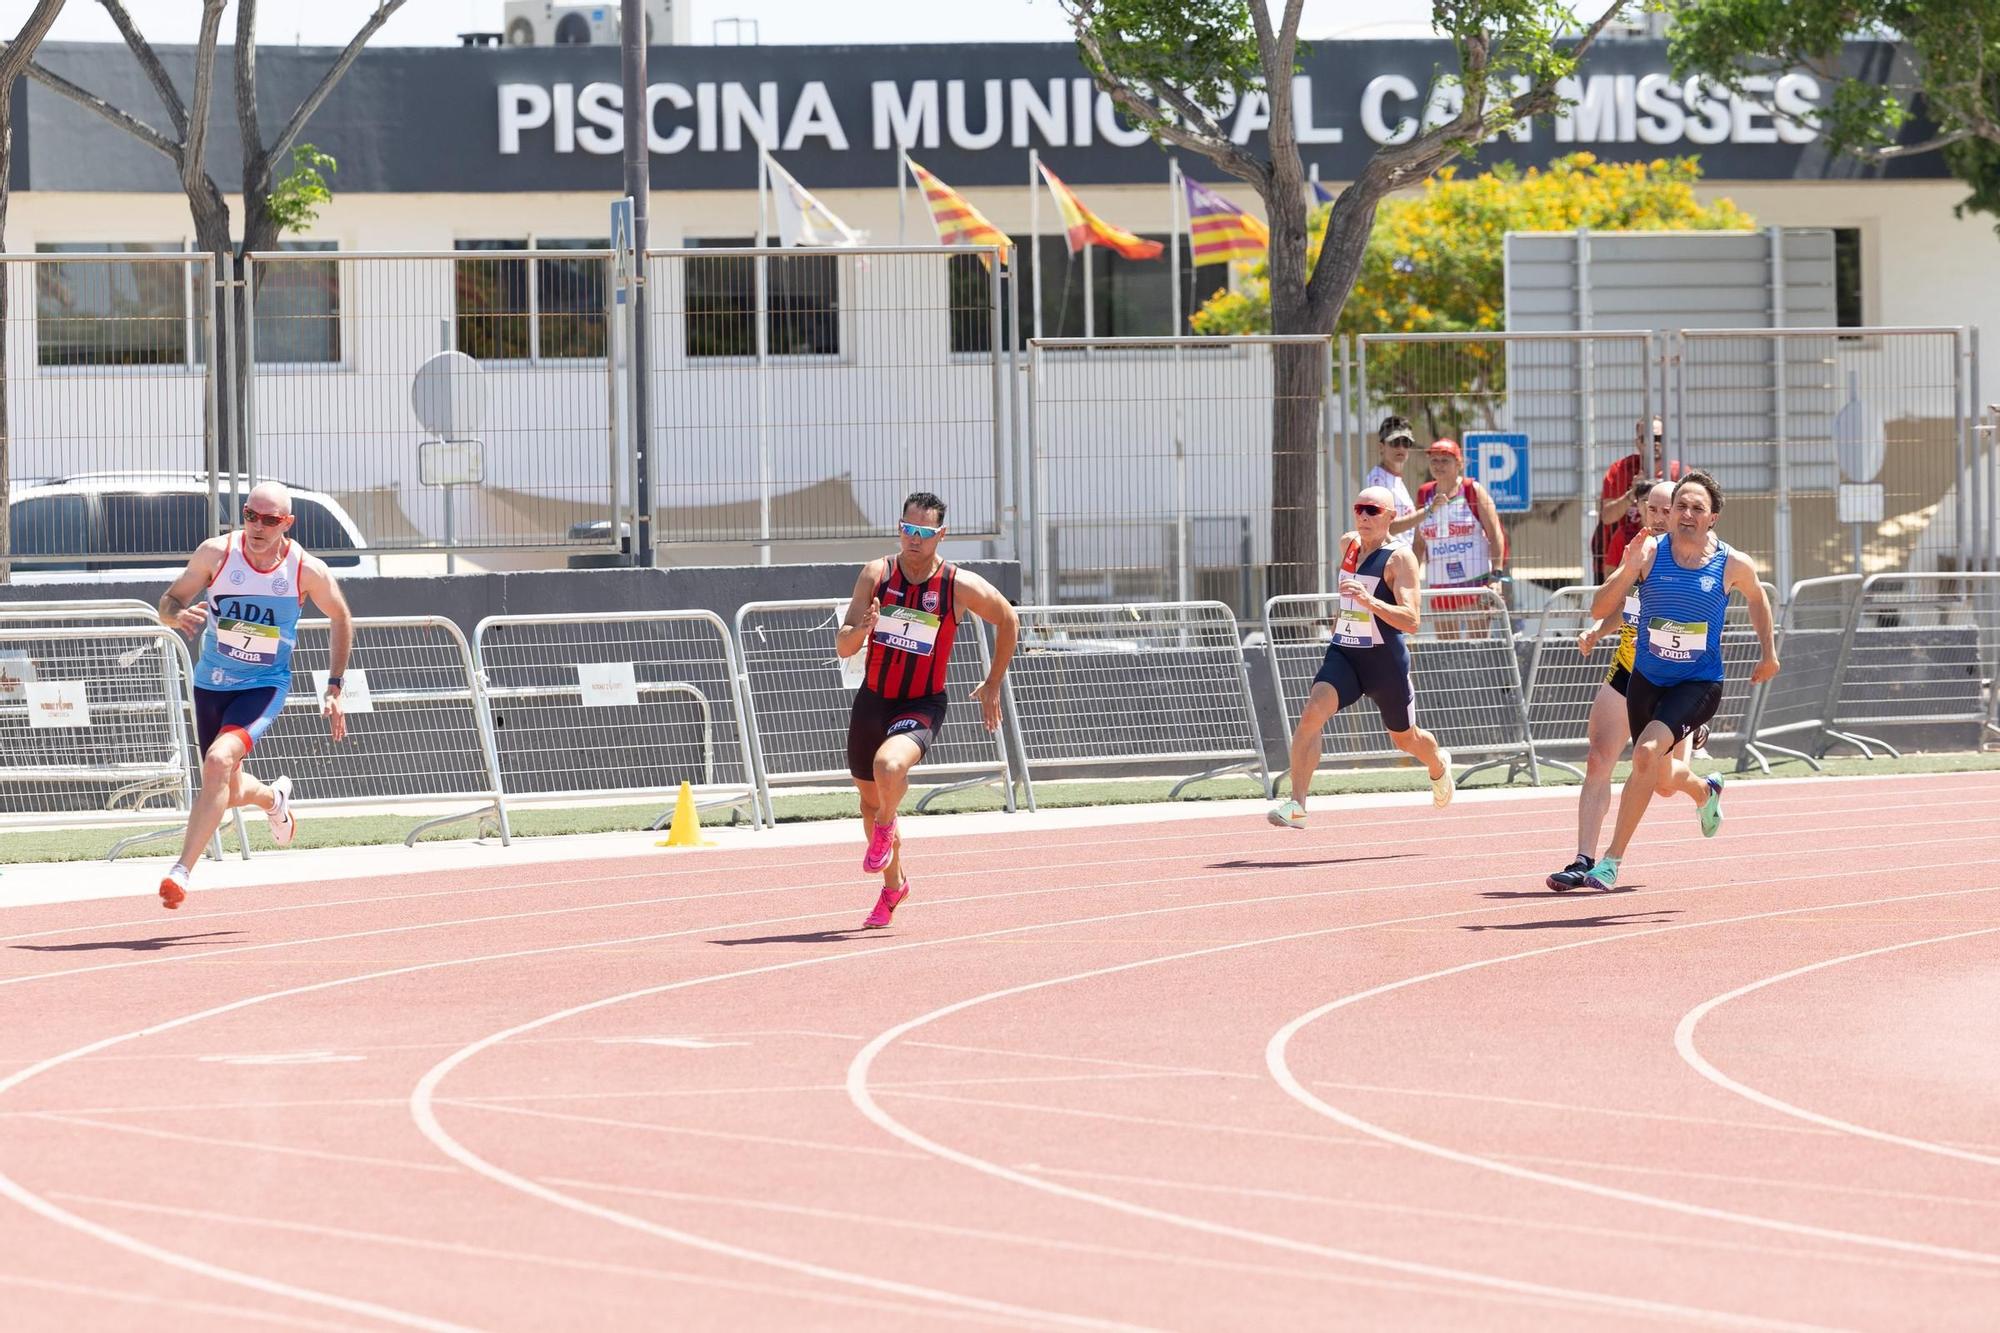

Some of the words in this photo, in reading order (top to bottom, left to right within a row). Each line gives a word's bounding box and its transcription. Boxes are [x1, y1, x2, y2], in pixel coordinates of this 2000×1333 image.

[498, 81, 849, 154] PISCINA
[1554, 73, 1822, 144] MISSES
[1478, 442, 1518, 494] P
[902, 622, 910, 636] 1
[1345, 622, 1352, 635] 4
[243, 635, 252, 649] 7
[1671, 635, 1681, 649] 5
